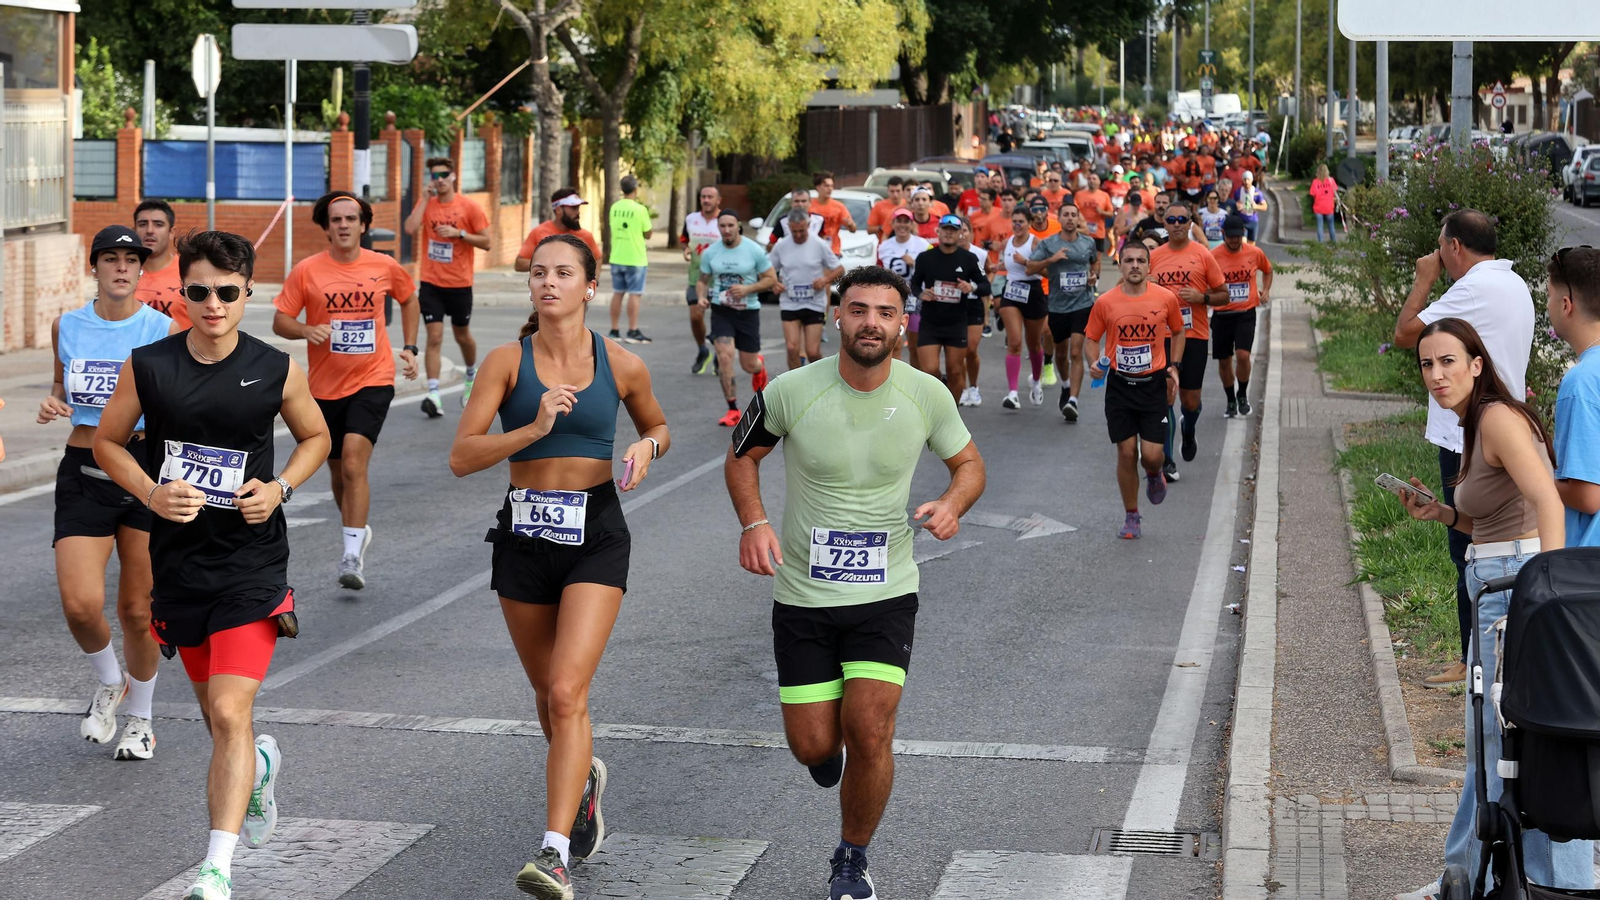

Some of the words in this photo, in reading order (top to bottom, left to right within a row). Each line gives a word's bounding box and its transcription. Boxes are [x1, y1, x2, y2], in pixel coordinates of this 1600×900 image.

[324, 291, 375, 308] XXIX
[342, 332, 365, 343] 829
[1118, 324, 1157, 338] XXIX
[1124, 355, 1143, 365] 931
[84, 375, 117, 392] 725
[181, 461, 223, 487] 770
[530, 505, 565, 525] 663
[833, 537, 854, 546] XXIX
[829, 548, 869, 567] 723
